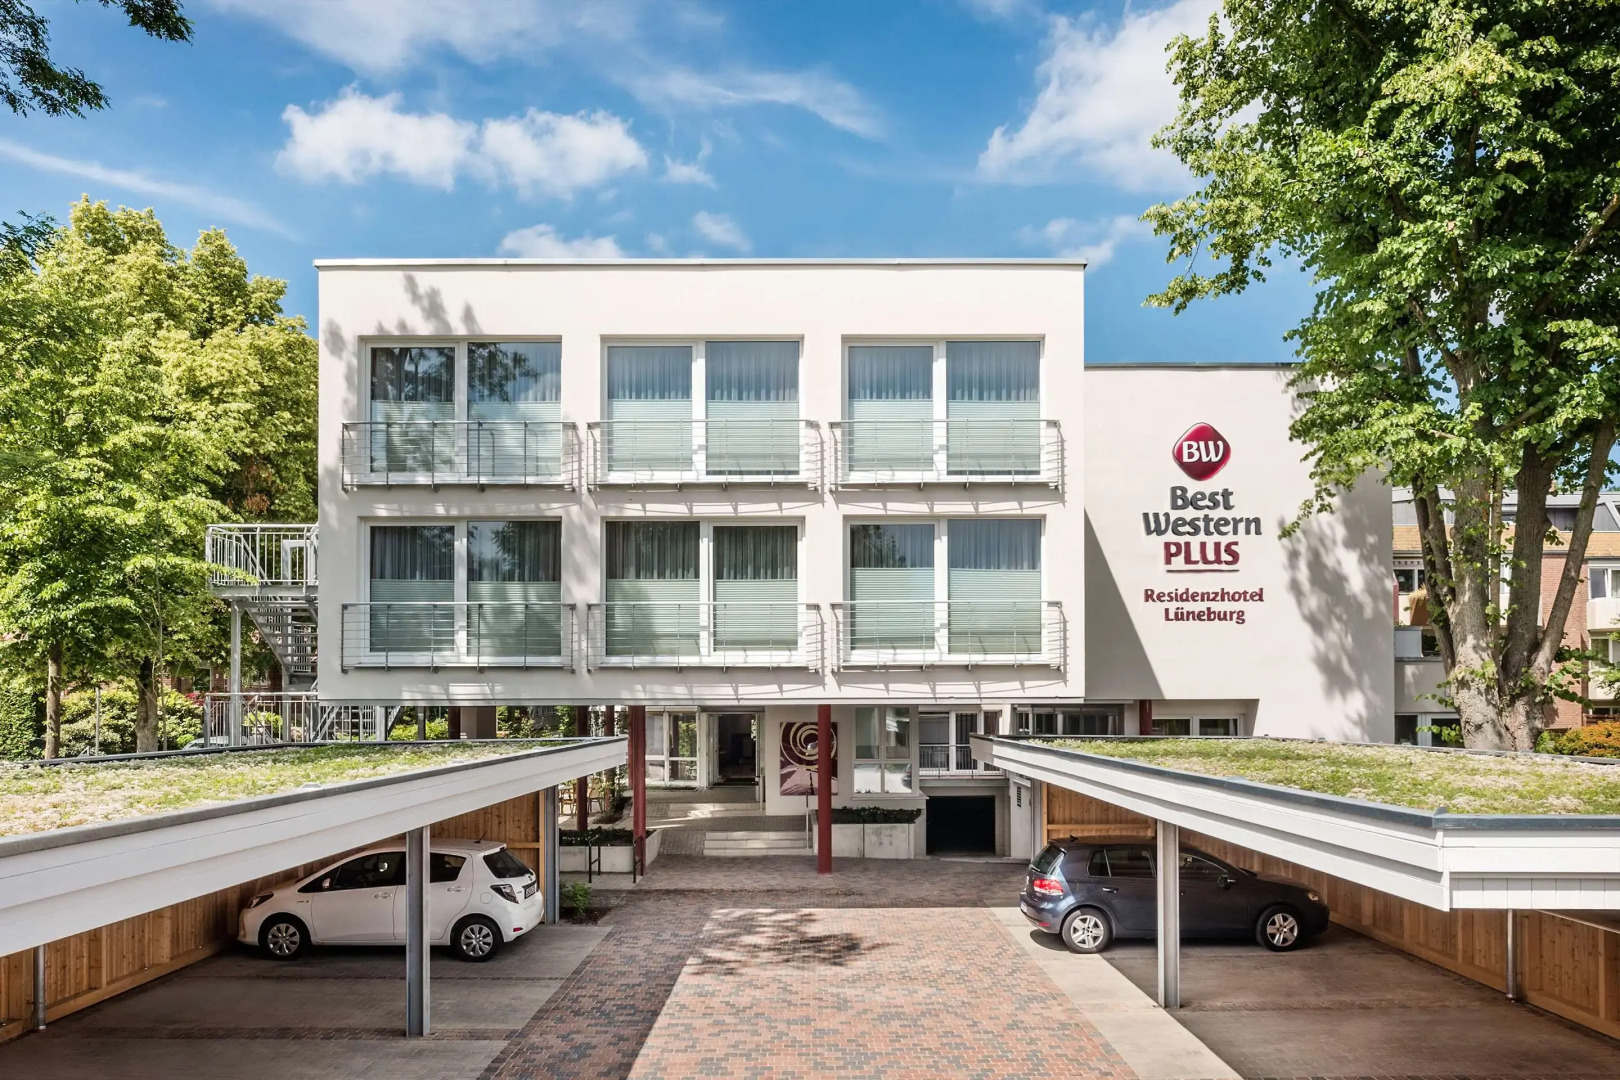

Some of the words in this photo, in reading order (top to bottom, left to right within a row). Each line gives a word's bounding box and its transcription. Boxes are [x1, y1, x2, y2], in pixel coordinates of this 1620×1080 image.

[1182, 441, 1224, 463] BW
[1170, 486, 1235, 511] Best
[1142, 512, 1263, 536] Western
[1164, 541, 1240, 566] PLUS
[1144, 588, 1264, 603] Residenzhotel
[1164, 607, 1246, 624] Lüneburg
